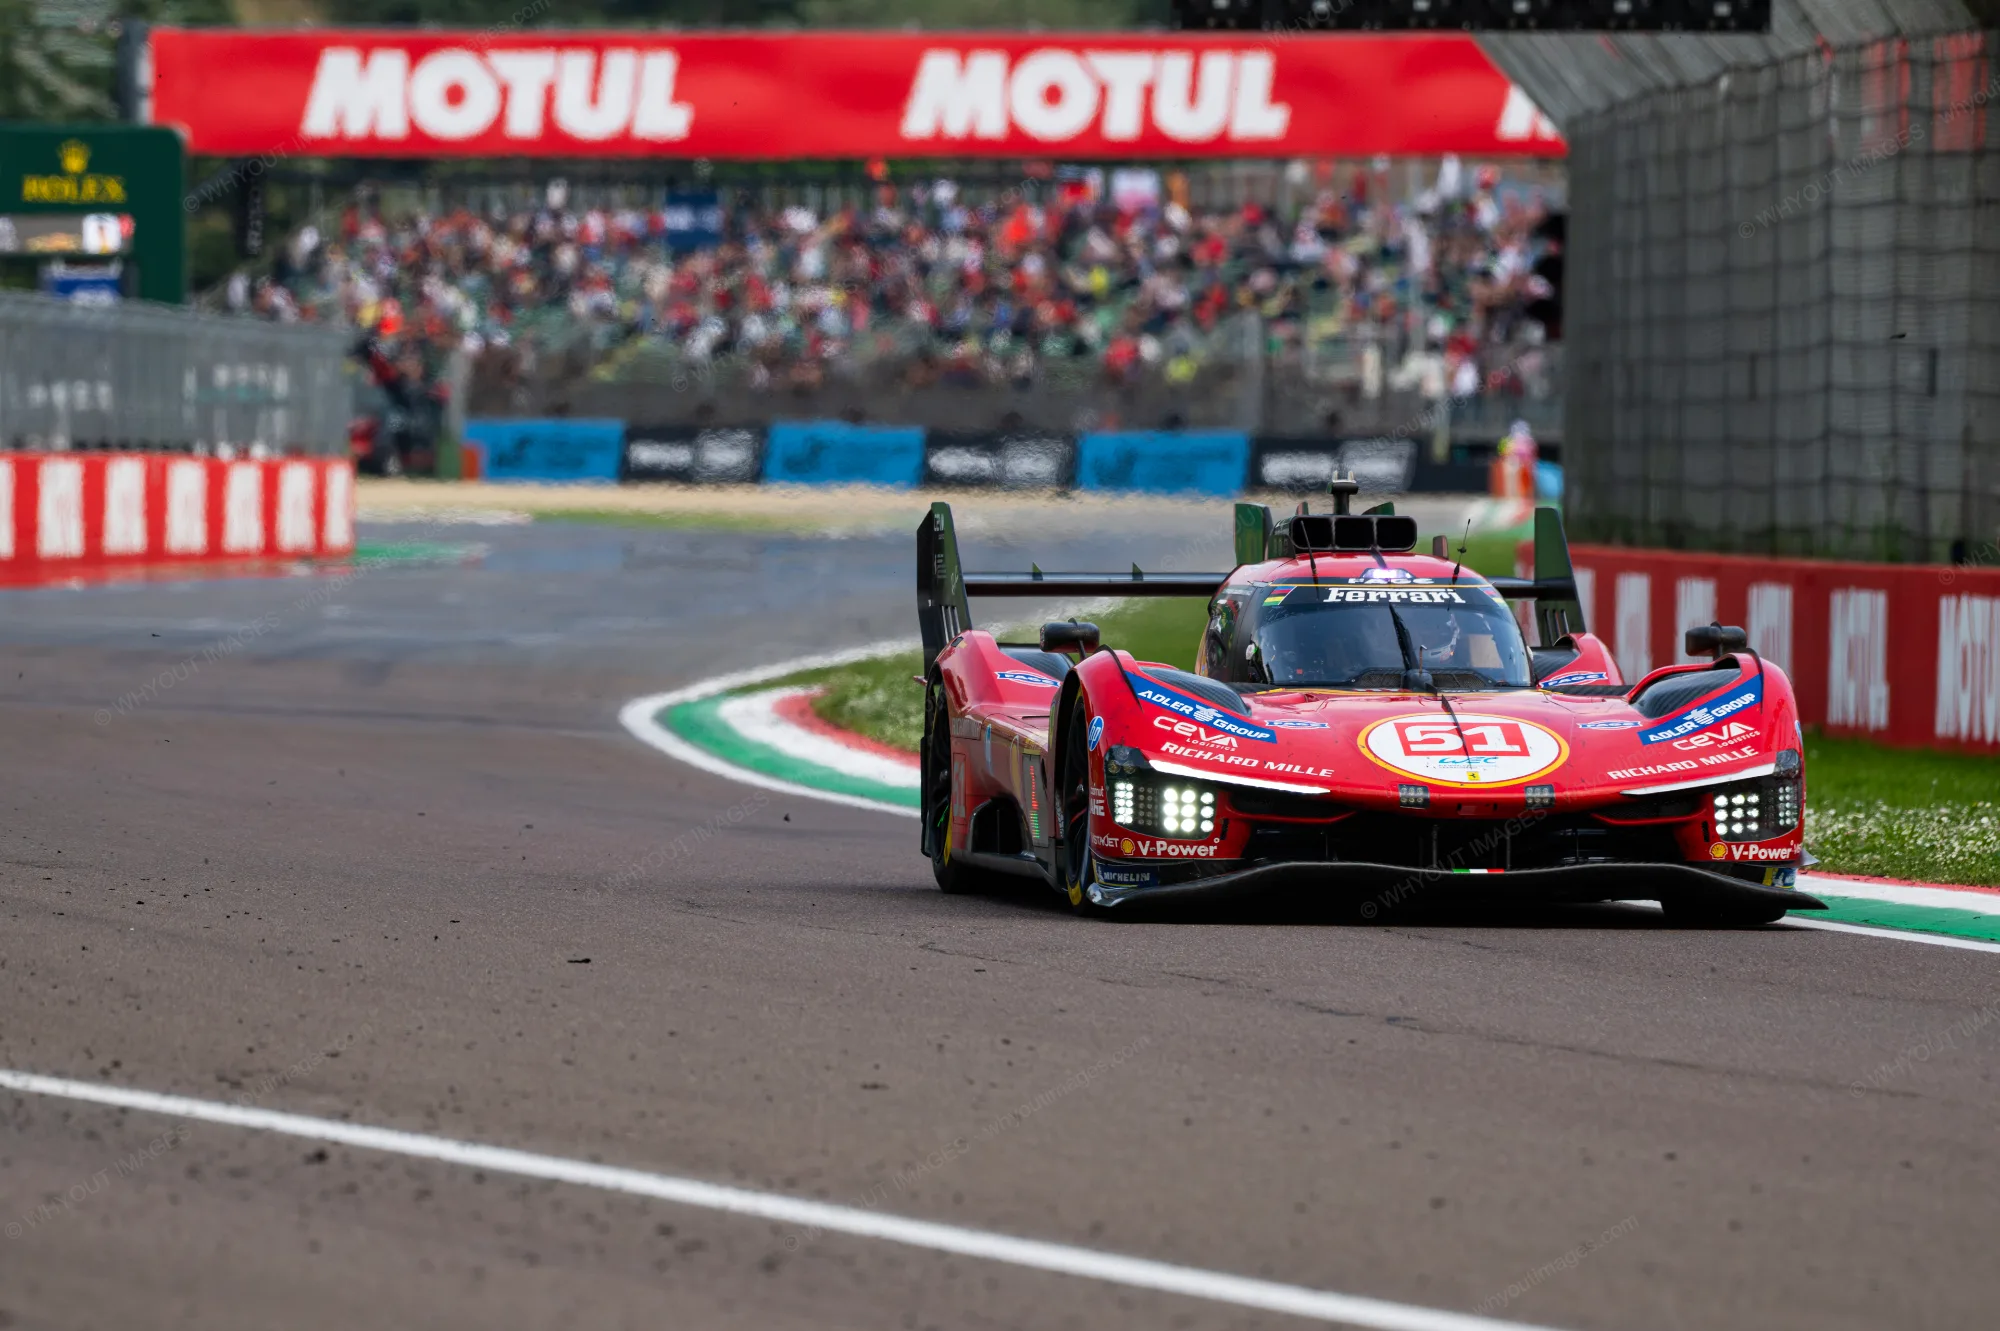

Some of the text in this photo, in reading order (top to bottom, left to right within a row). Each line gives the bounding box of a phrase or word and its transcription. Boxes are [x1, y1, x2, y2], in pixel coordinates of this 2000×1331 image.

[301, 46, 694, 142] MOTUL
[900, 47, 1291, 142] MOTUL
[1322, 587, 1466, 603] Ferrari
[1138, 690, 1271, 739] ADLER GROUP
[1648, 693, 1756, 742] ADLER GROUP
[1186, 738, 1236, 752] LOGISTICS
[1404, 725, 1522, 752] 51
[1716, 730, 1761, 749] LOGISTICS
[1160, 742, 1335, 778] RICHARD MILLE
[1607, 746, 1760, 780] RICHARD MILLE
[1137, 840, 1218, 857] V-Power
[1731, 843, 1792, 860] V-Power
